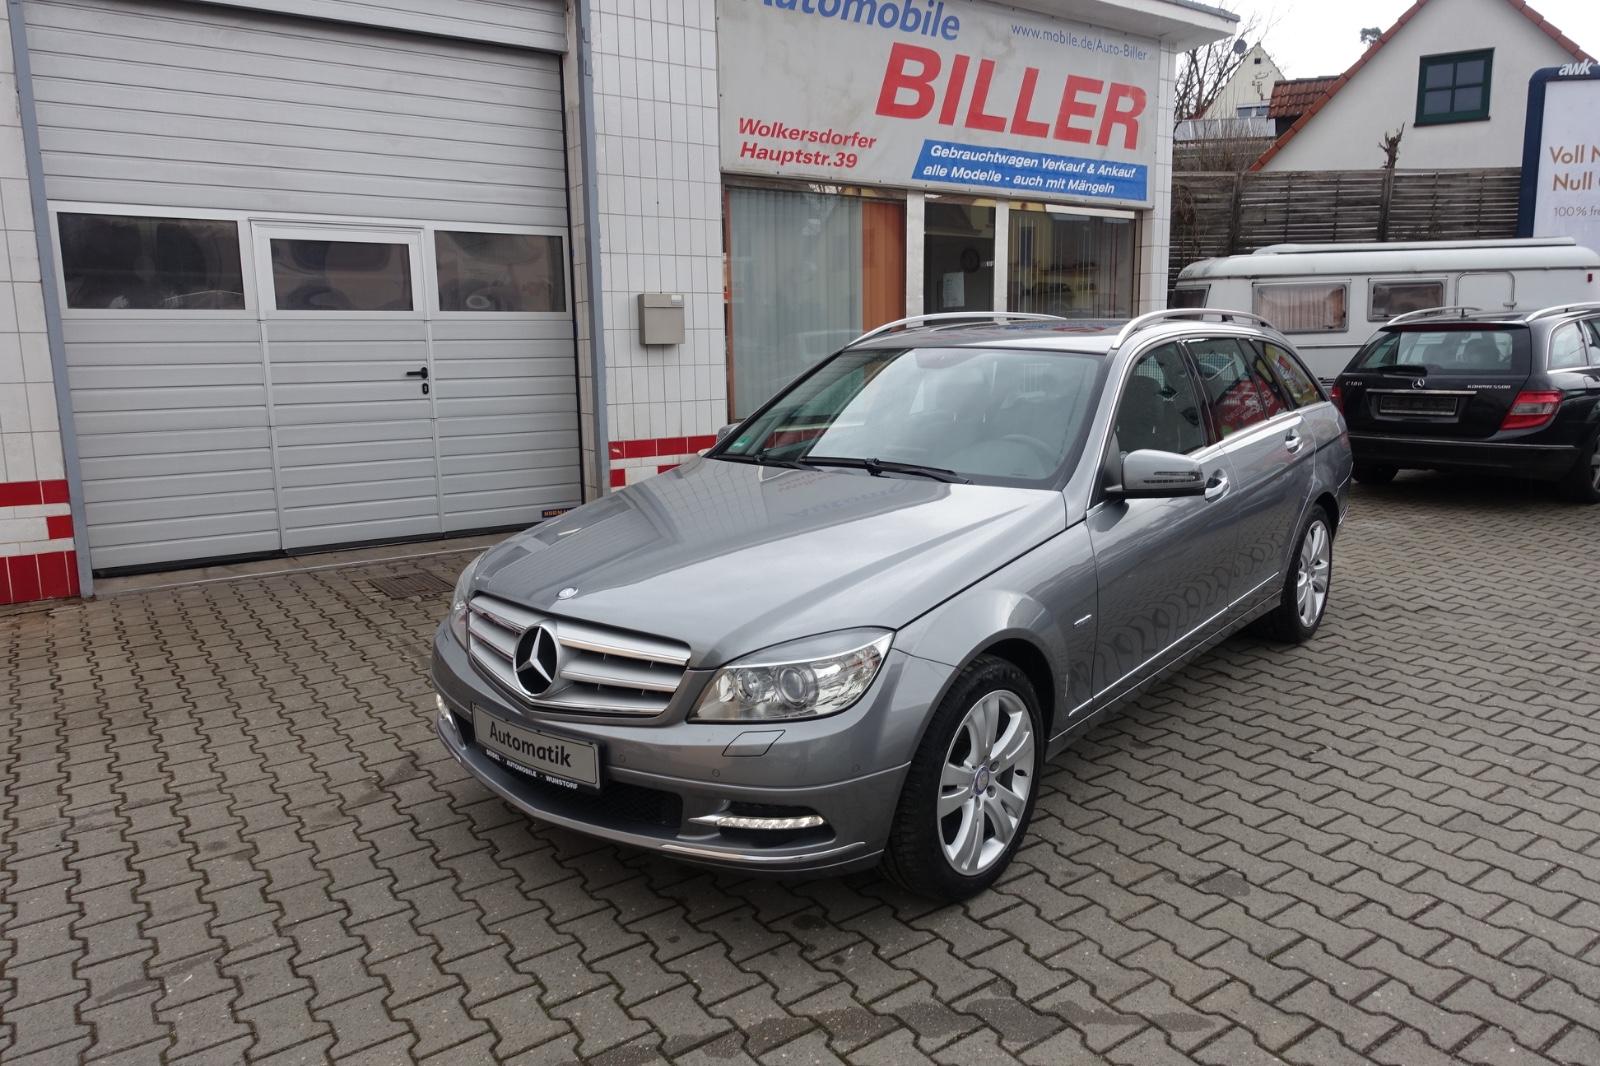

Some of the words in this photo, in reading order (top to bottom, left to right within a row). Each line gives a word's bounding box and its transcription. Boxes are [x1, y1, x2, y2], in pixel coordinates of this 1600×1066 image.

[763, 0, 960, 40] omobile
[1011, 24, 1148, 60] www.mobile.de/Auto-Biller
[1559, 59, 1592, 76] awk
[875, 41, 1147, 150] BILLER
[738, 117, 877, 149] Wolkersdorfer
[740, 141, 858, 168] Hauptstr.39
[930, 145, 1039, 169] Gebrauchtwagen
[1041, 158, 1086, 174] Verkauf
[1086, 163, 1095, 174] &
[1097, 165, 1137, 178] Ankauf
[1549, 144, 1585, 165] Voll
[923, 164, 948, 177] alle
[951, 166, 1002, 183] Modelle
[1013, 173, 1043, 187] auch
[1046, 178, 1066, 190] mit
[1067, 178, 1115, 195] Mängeln
[1552, 171, 1592, 191] Null
[489, 721, 572, 768] Automatik
[506, 760, 537, 777] AUTOMOBILE
